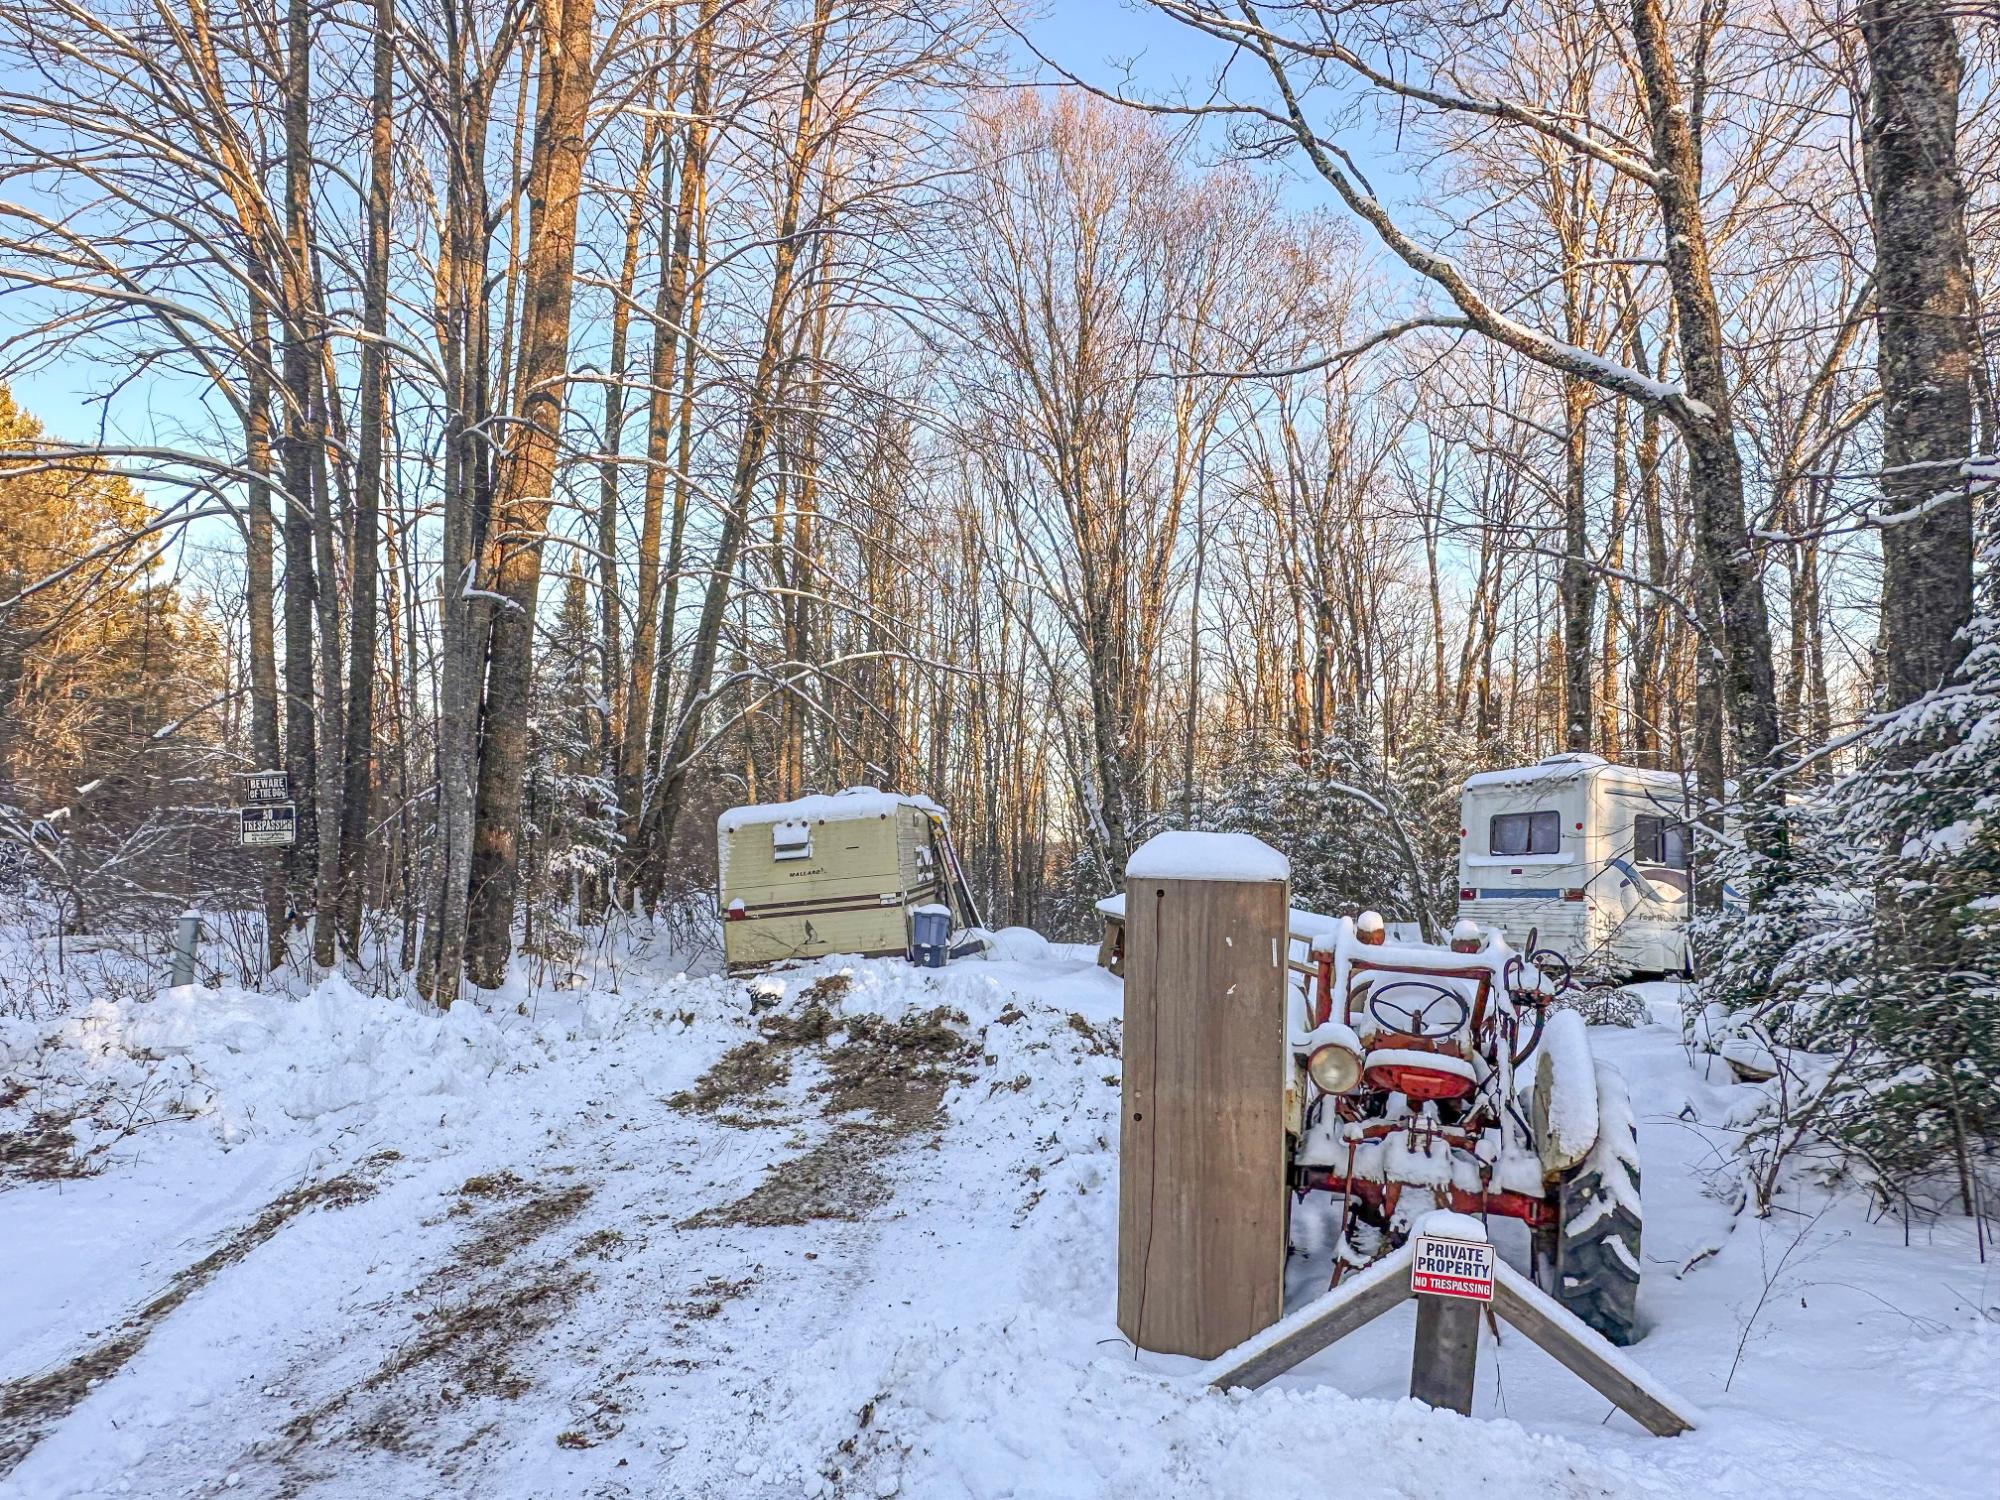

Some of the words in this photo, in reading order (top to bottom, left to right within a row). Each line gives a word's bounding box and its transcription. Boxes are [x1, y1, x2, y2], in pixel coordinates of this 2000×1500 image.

[251, 778, 284, 789] BEWARE
[250, 789, 258, 798] OF
[260, 789, 271, 798] THE
[244, 819, 292, 831] TRESPASSING
[1426, 1243, 1484, 1262] PRIVATE
[1418, 1257, 1489, 1278] PROPERTY
[1414, 1275, 1427, 1287] NO
[1429, 1278, 1490, 1295] TRESPASSING
